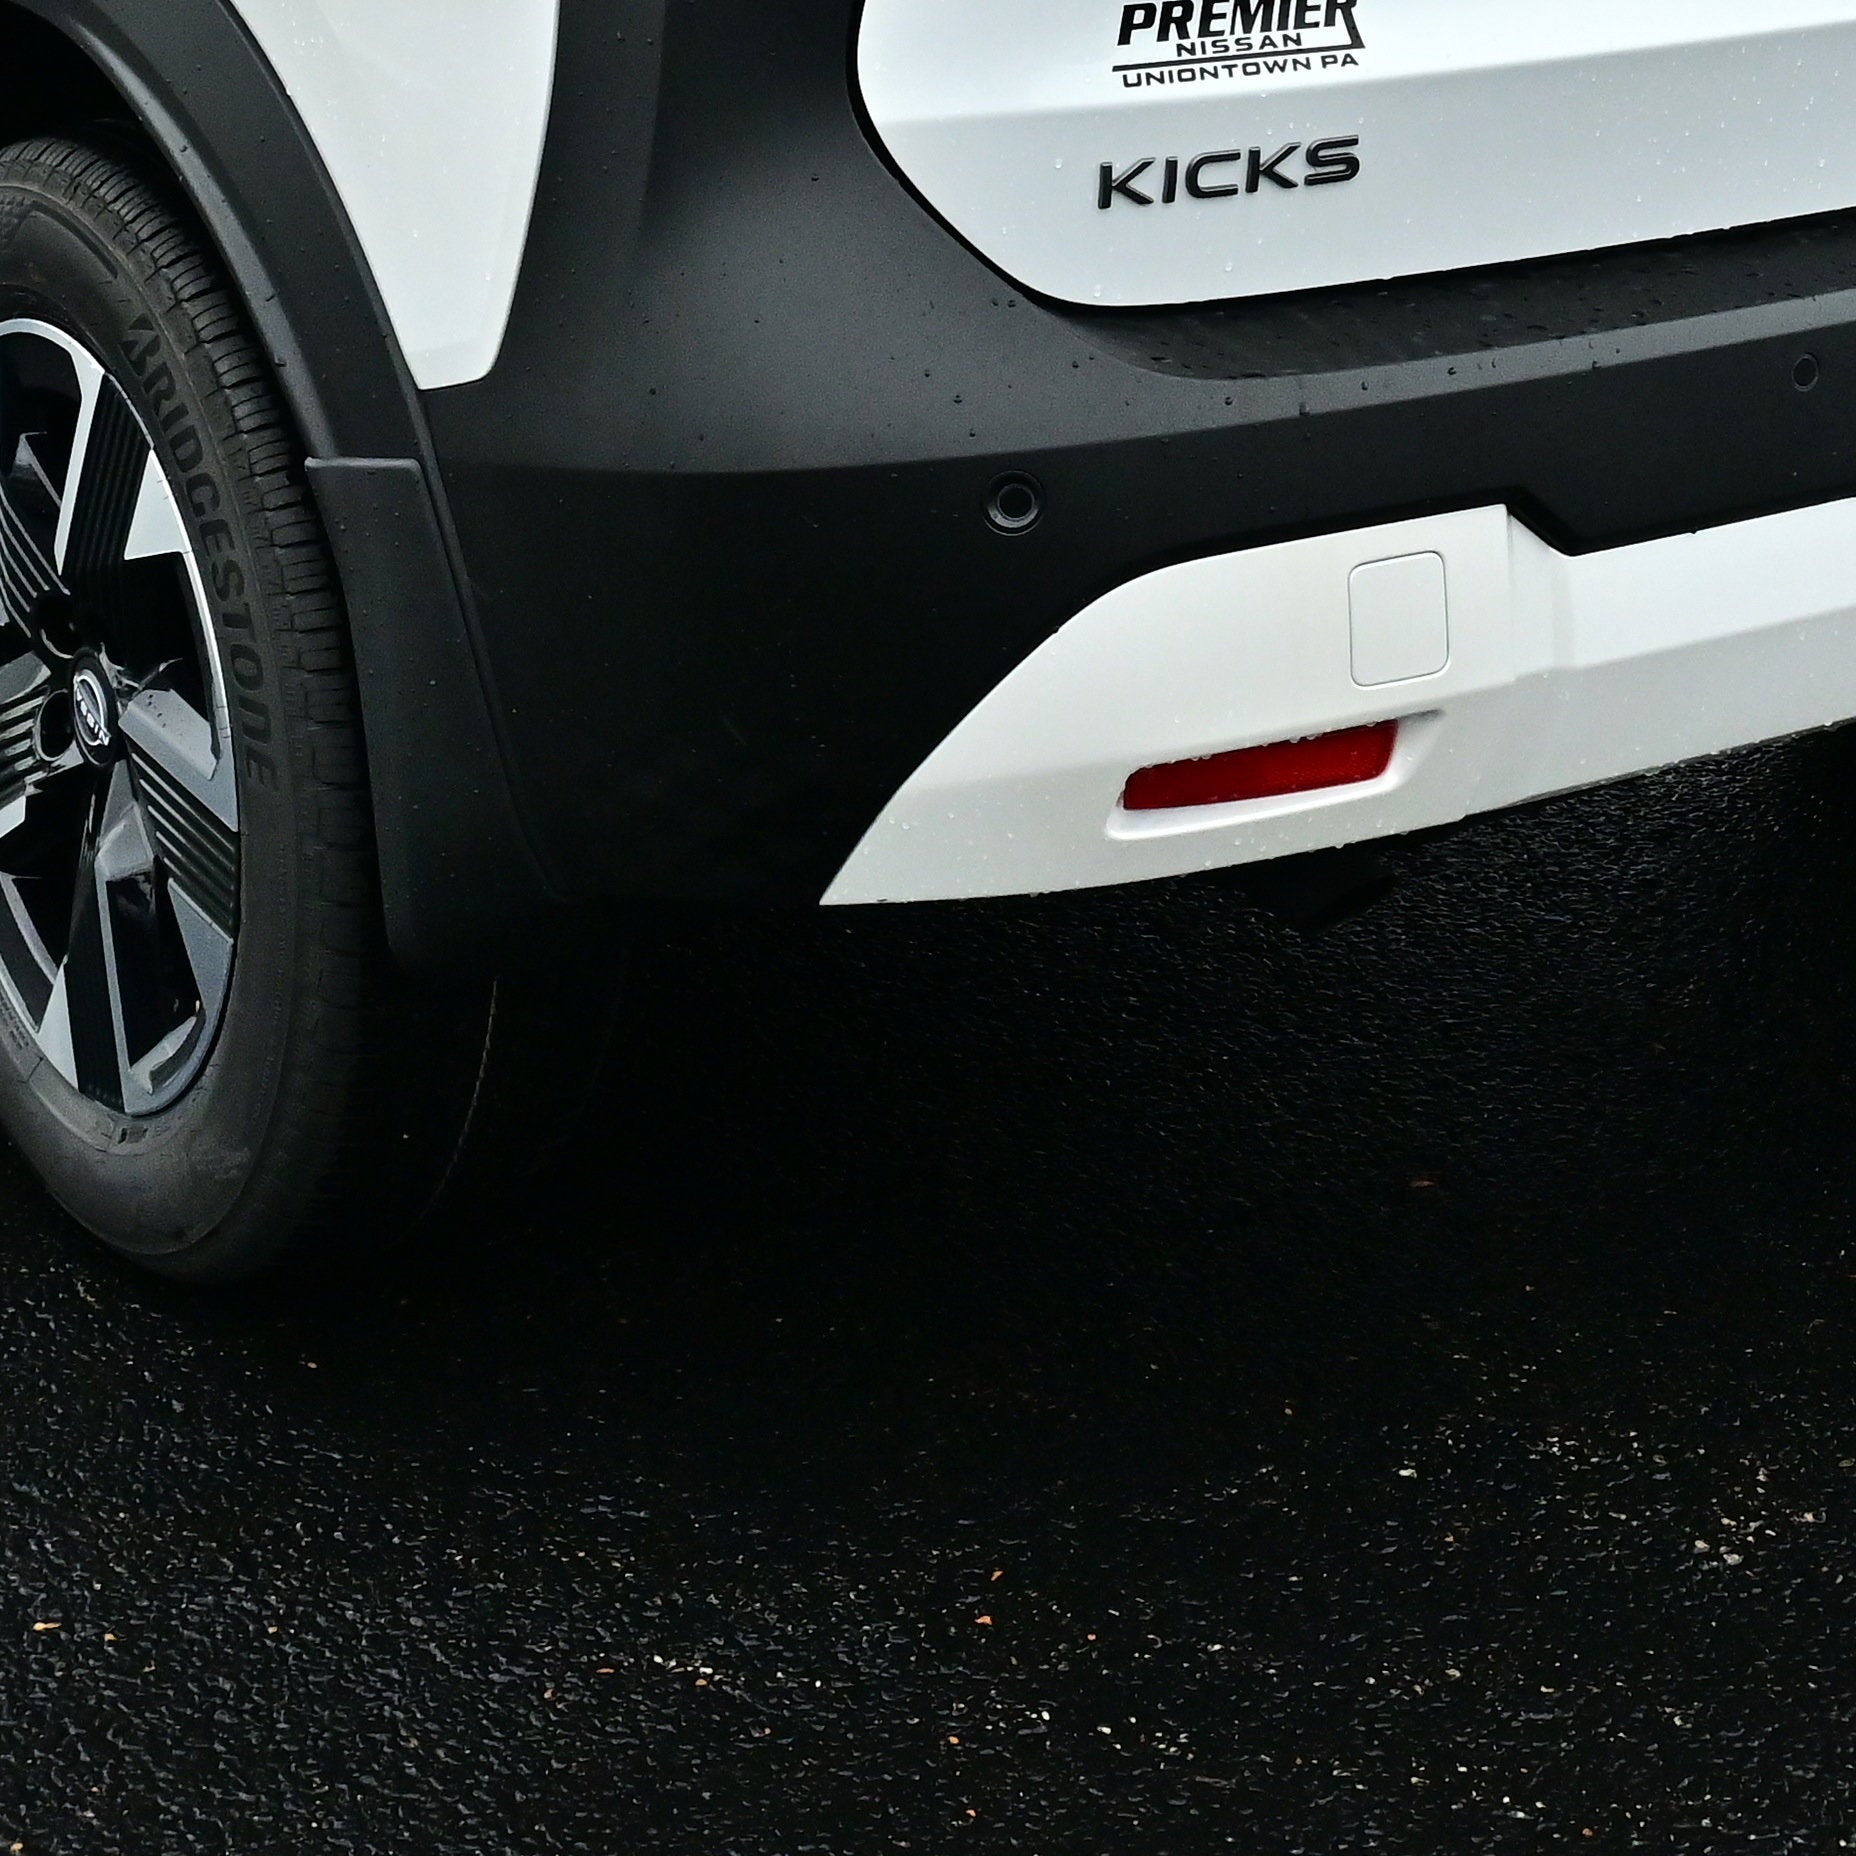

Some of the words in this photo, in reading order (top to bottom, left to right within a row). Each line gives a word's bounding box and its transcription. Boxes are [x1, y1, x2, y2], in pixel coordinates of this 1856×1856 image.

[1122, 56, 1312, 88] UNIONTOWN
[1321, 53, 1359, 68] PA
[1176, 32, 1303, 57] NISSAN
[1097, 134, 1360, 210] KICKS
[122, 311, 280, 792] BRIDGESTONE
